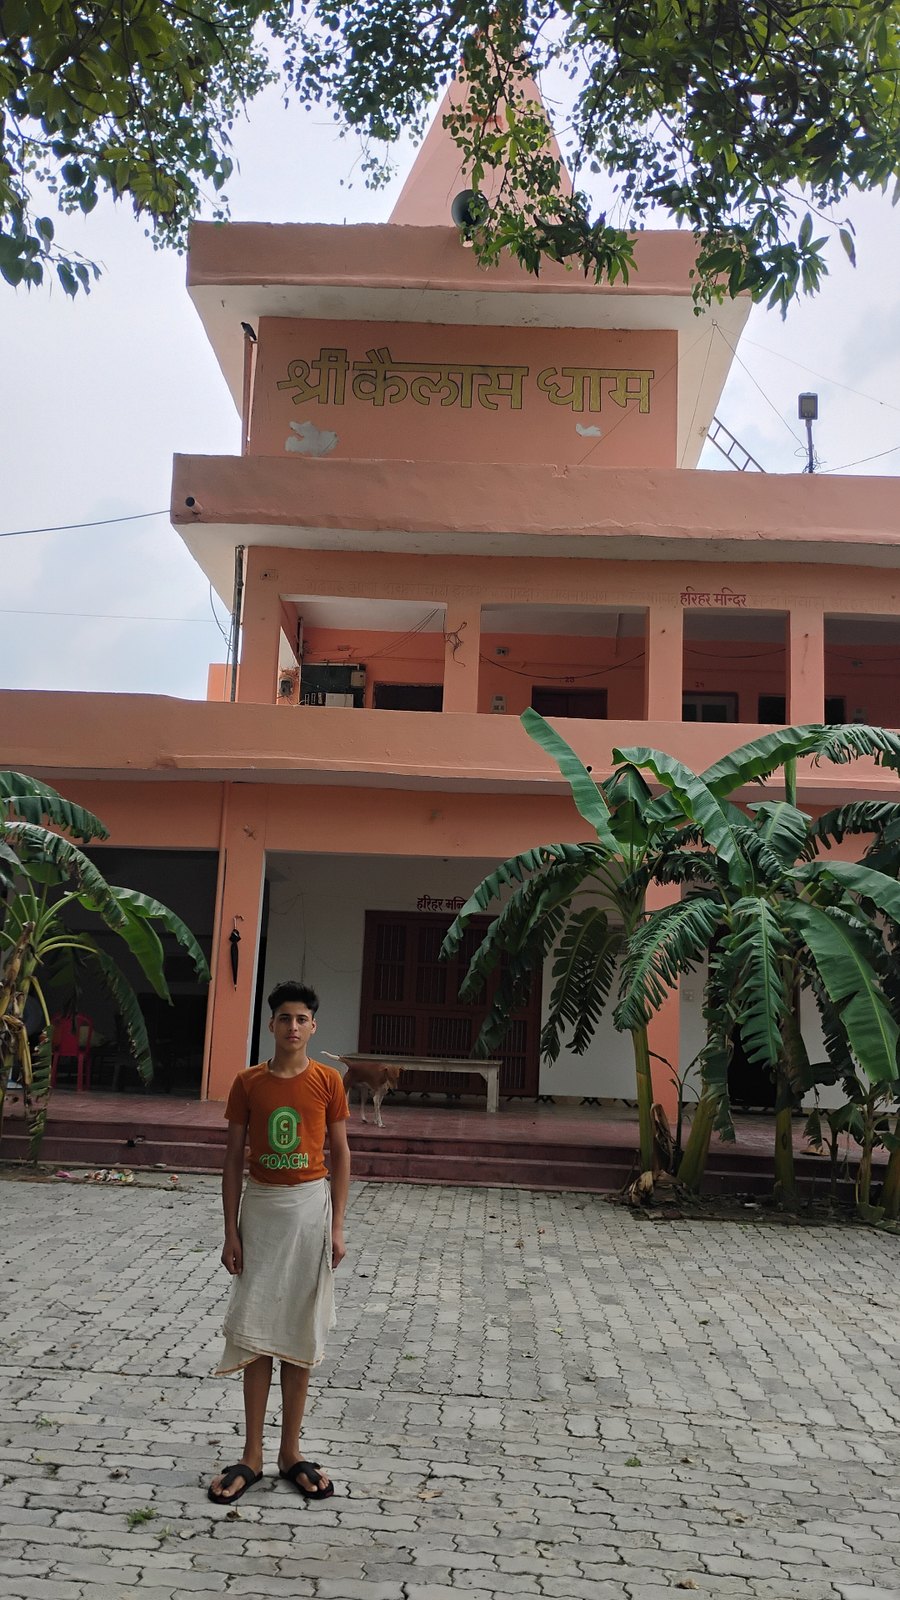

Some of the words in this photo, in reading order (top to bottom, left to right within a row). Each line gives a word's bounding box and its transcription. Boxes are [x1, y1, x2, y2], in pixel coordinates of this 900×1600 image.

[276, 347, 350, 405] श्री
[537, 366, 655, 413] धाम
[679, 585, 712, 607] हरिहर
[712, 586, 747, 607] मन्दिर
[416, 894, 444, 912] हरिहर
[260, 1153, 309, 1169] COACH
